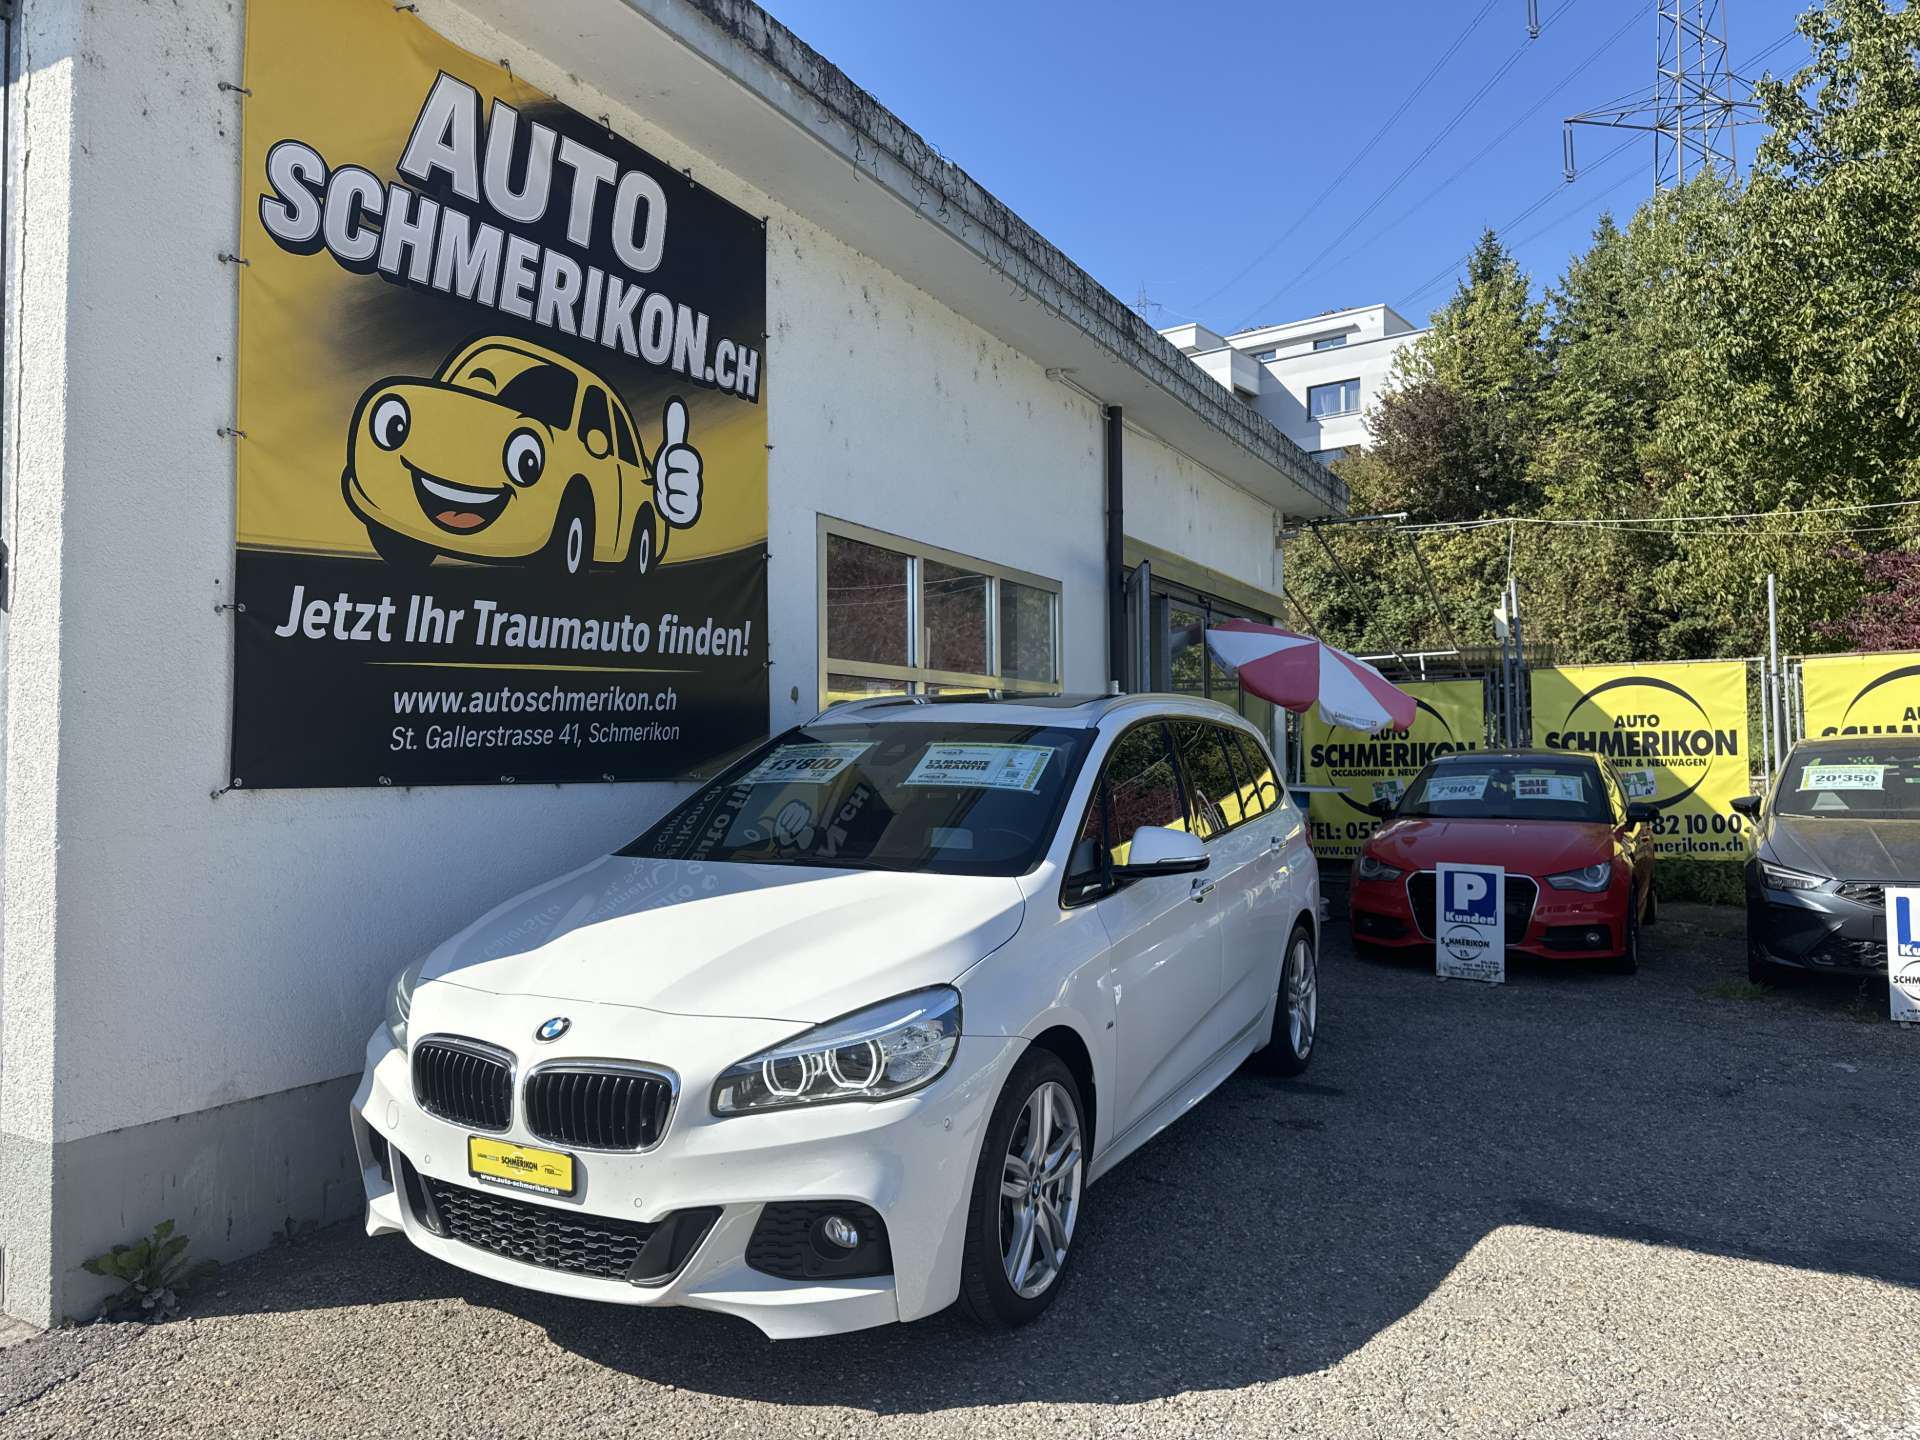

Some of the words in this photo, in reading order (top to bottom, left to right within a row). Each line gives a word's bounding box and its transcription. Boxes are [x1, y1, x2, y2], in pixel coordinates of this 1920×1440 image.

[398, 69, 668, 274] AUTO
[260, 141, 760, 399] SCHMERIKON.CH
[275, 585, 397, 643] Jetzt
[404, 594, 464, 645] Ihr
[472, 599, 650, 654] Traumauto
[657, 613, 752, 657] finden!
[392, 685, 678, 714] www.autoschmerikon.ch
[1613, 714, 1661, 728] AUTO
[389, 725, 418, 752] St.
[425, 723, 554, 750] Gallerstrasse
[559, 722, 583, 749] 41,
[588, 721, 680, 745] Schmerikon
[1545, 730, 1738, 756] SCHMERIKON
[768, 757, 844, 771] 13'800
[1331, 768, 1385, 777] OCCASIONEN
[1387, 768, 1395, 777] &
[1635, 758, 1643, 767] &
[1647, 757, 1707, 767] NEUWAGEN
[1815, 774, 1876, 783] 20'350
[1686, 814, 1708, 834] 10
[1712, 813, 1743, 834] 00
[1453, 872, 1488, 911] P
[1445, 911, 1496, 925] Kunden
[501, 1156, 538, 1171] SCHMERIKON
